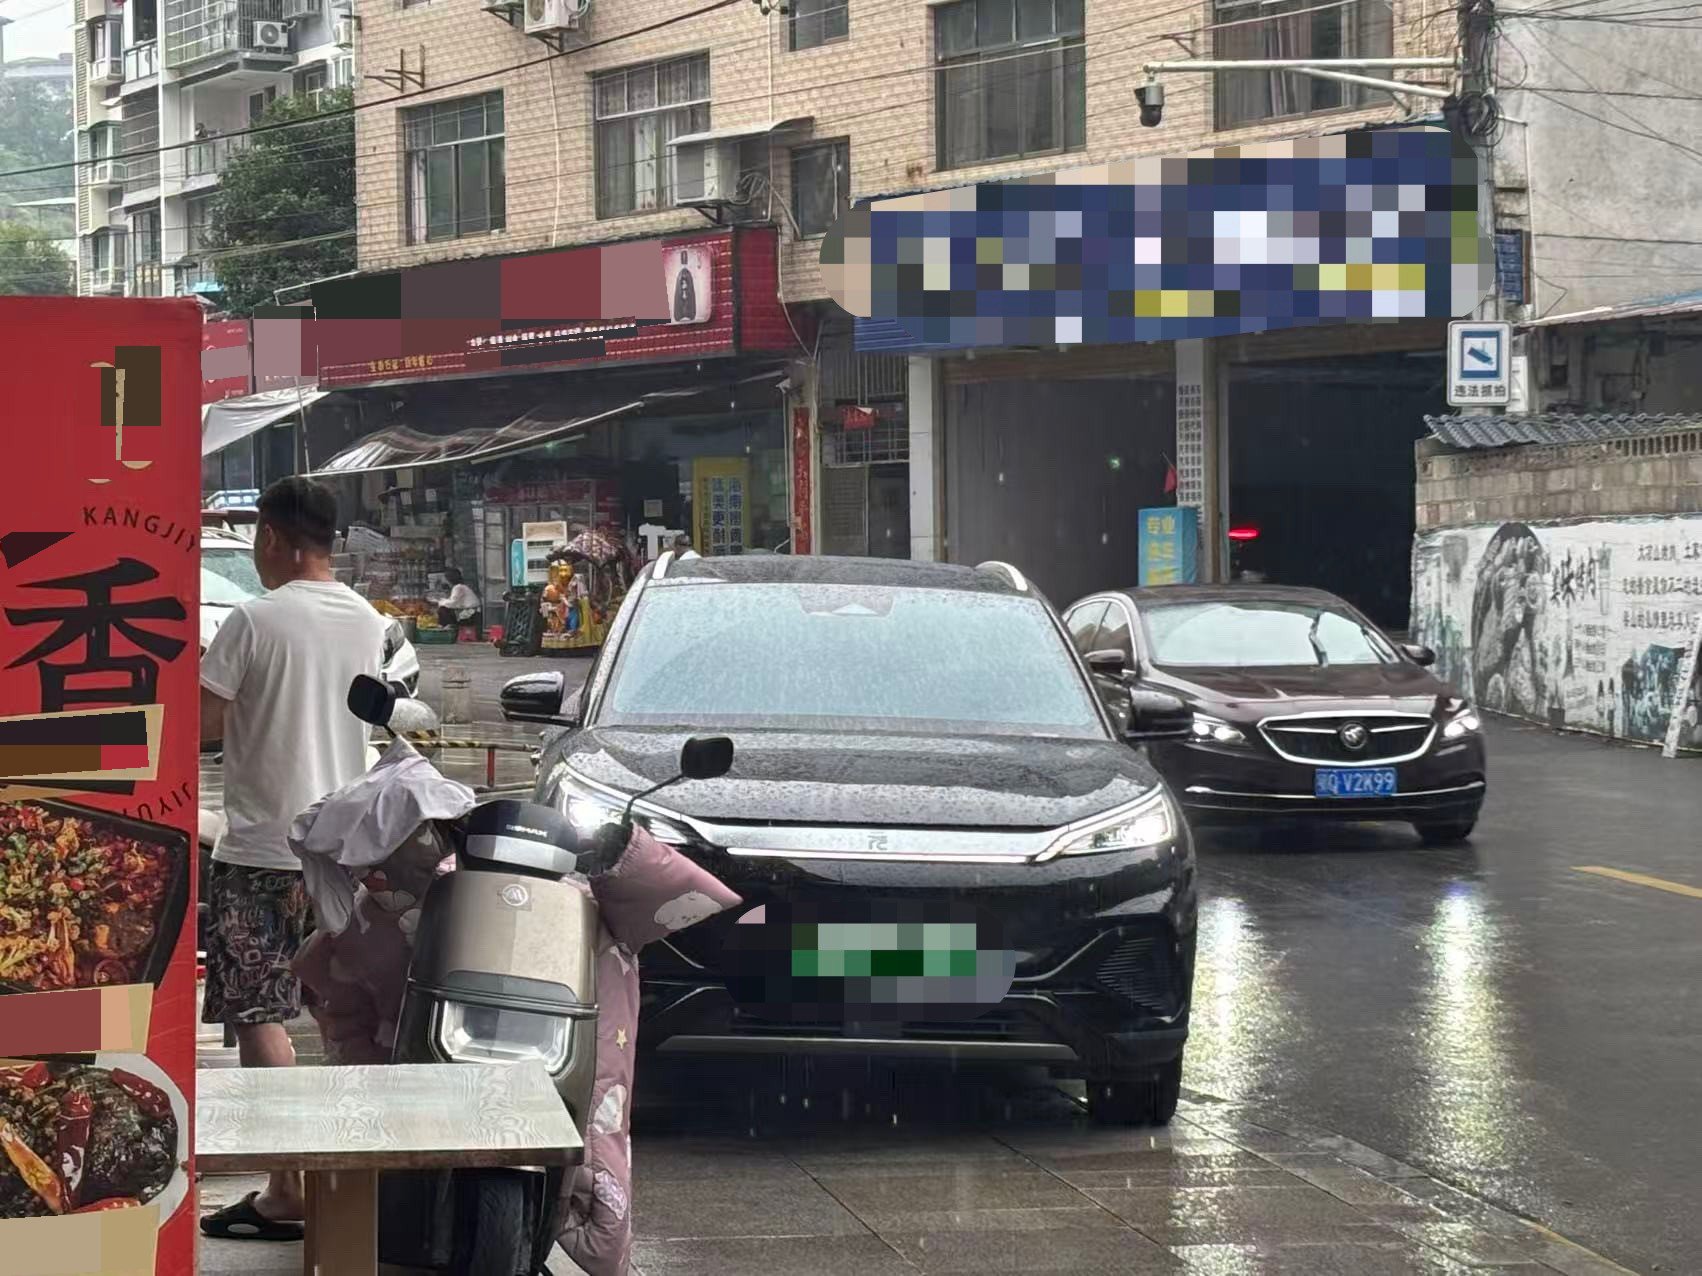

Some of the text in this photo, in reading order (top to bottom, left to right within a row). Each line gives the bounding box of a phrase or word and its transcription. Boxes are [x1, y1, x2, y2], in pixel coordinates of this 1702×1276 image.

[1455, 384, 1506, 397] 违法抓拍
[3, 558, 188, 713] 香
